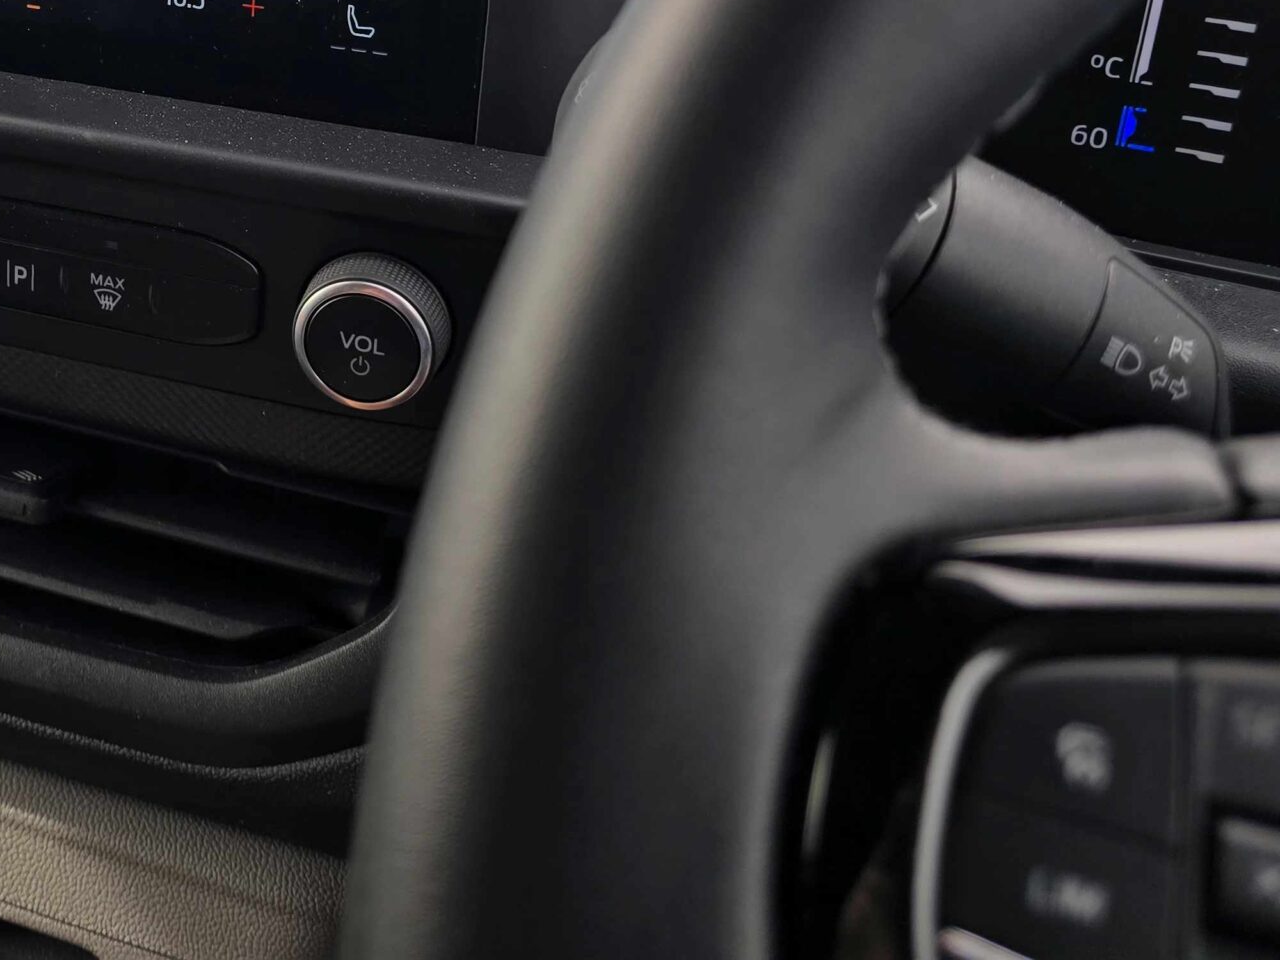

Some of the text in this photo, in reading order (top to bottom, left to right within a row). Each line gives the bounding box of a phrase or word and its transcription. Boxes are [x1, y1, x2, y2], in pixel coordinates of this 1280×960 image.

[1070, 123, 1108, 149] 60
[89, 271, 126, 291] MAX
[339, 331, 386, 357] VOL
